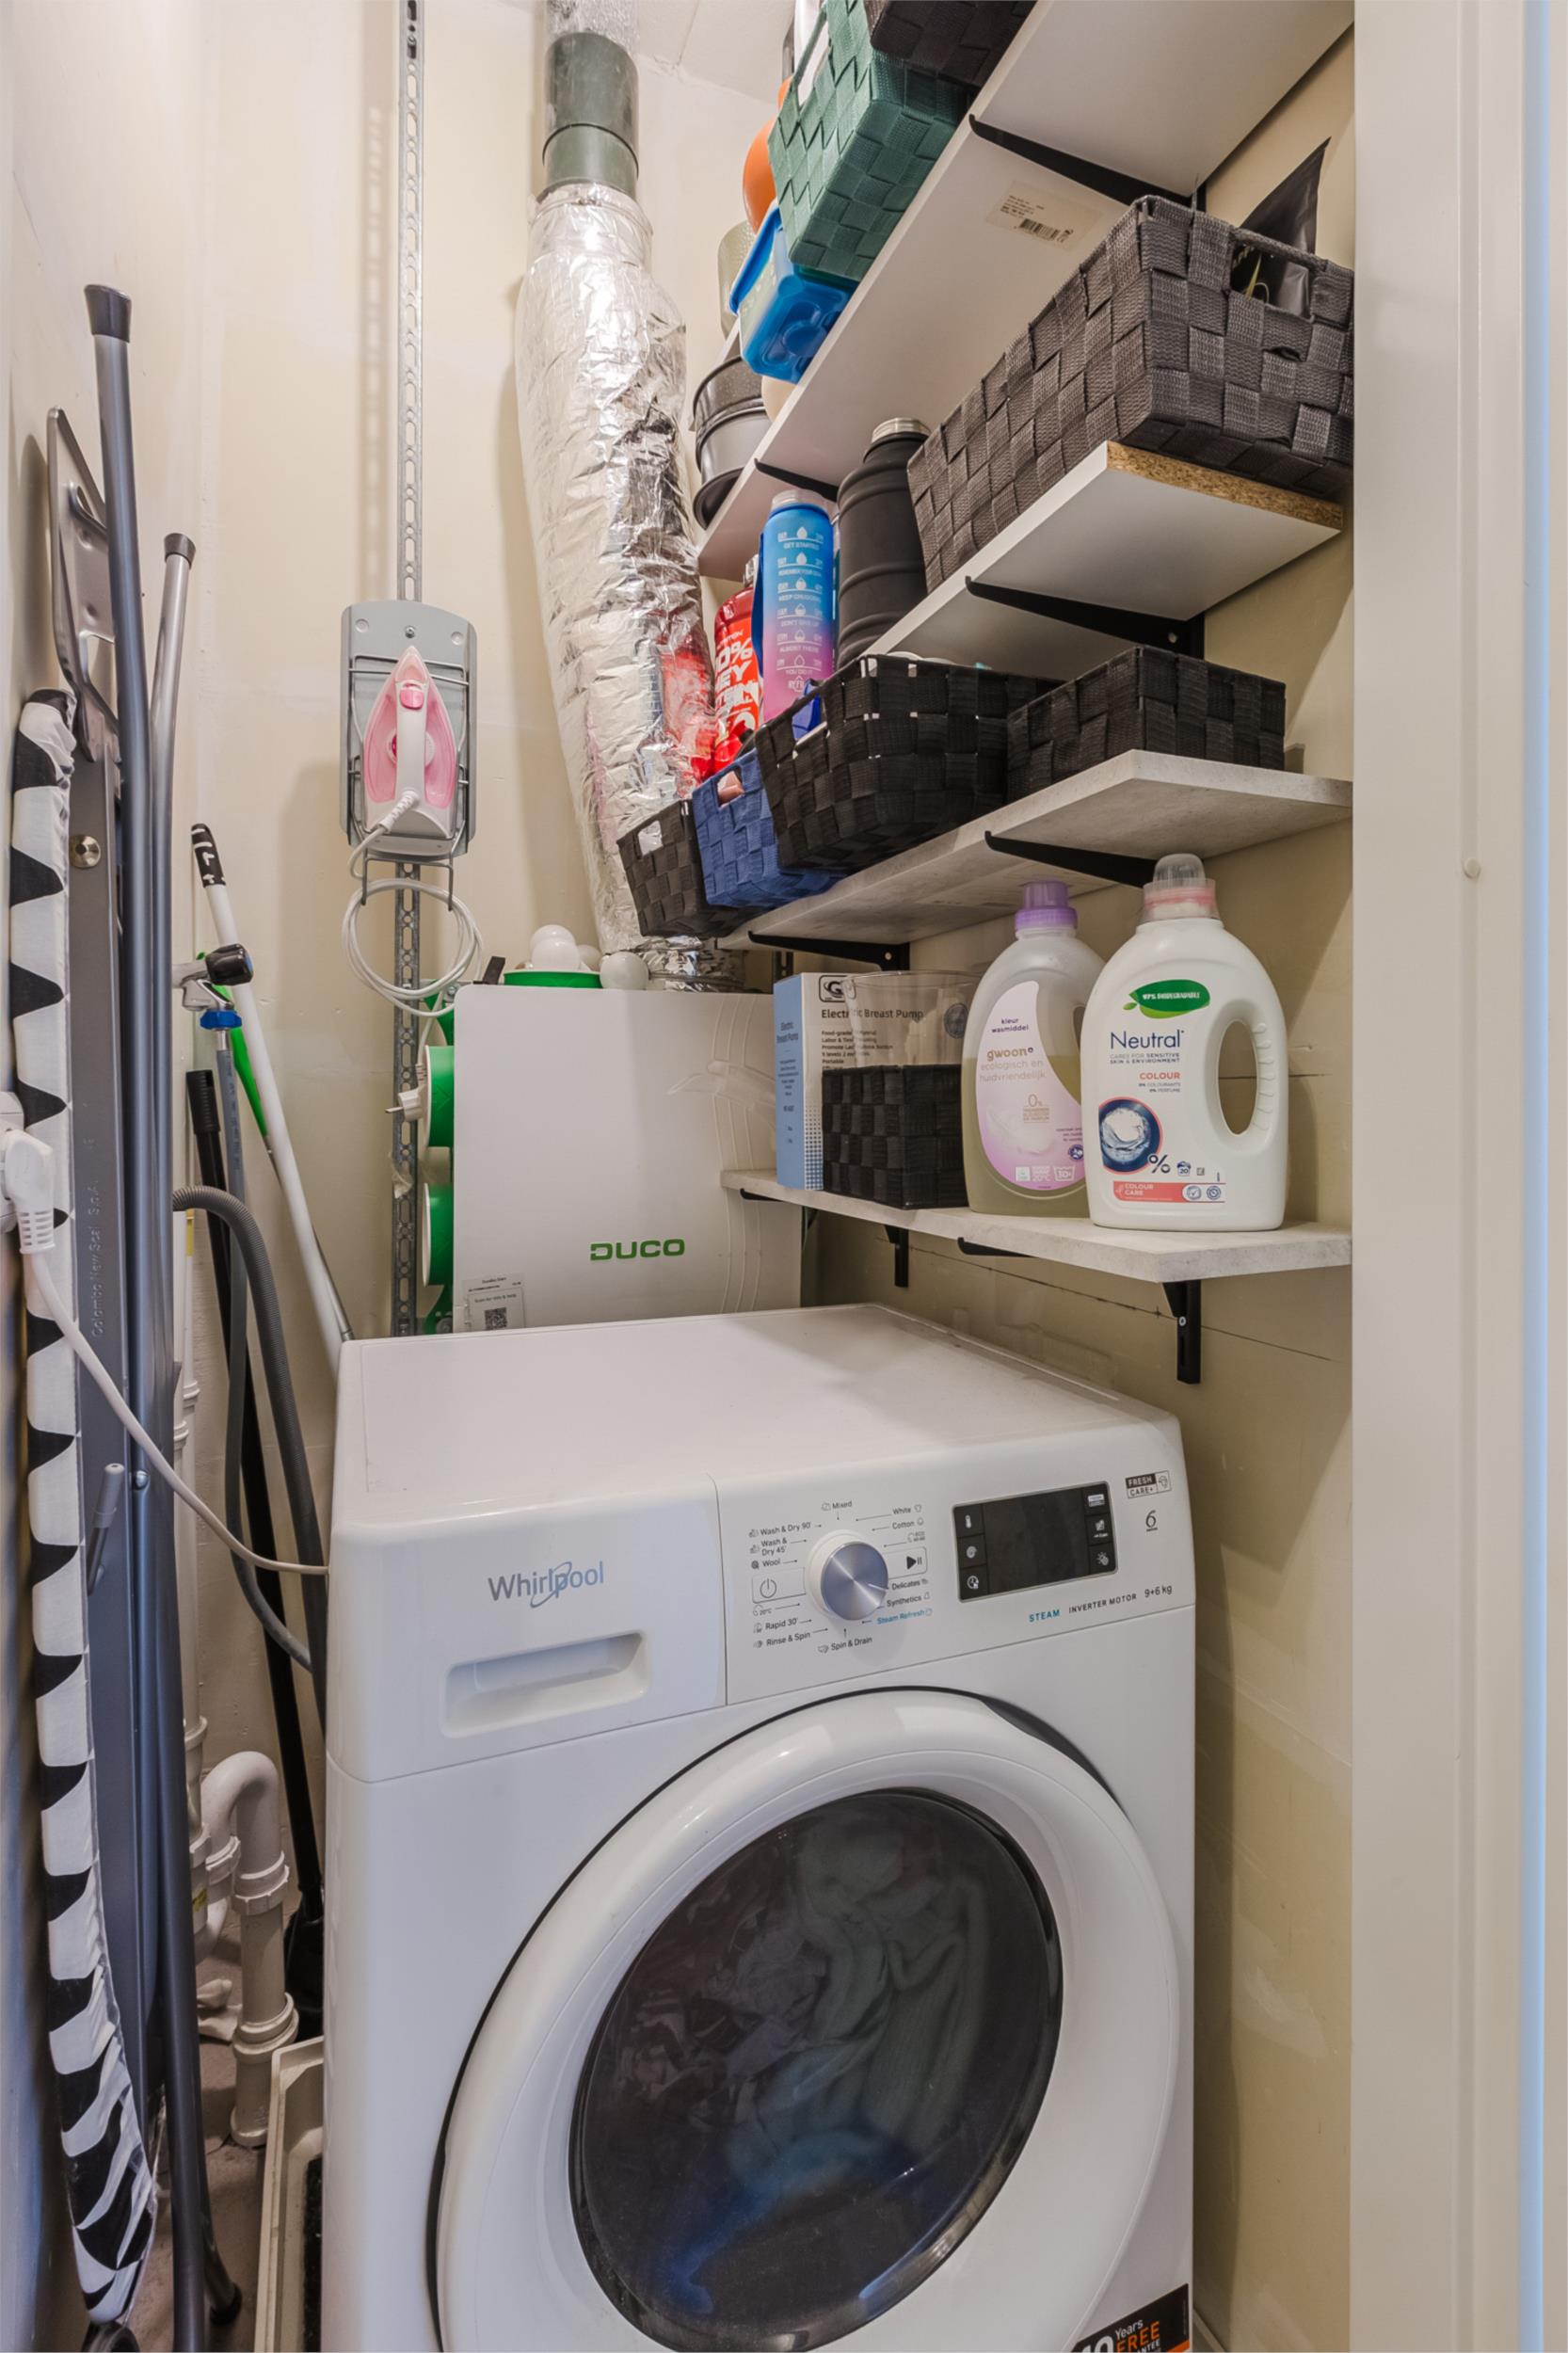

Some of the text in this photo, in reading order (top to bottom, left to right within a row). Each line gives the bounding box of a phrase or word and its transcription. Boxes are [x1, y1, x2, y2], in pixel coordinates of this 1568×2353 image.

[864, 1009, 894, 1018] Breast
[896, 1009, 924, 1021] Pump
[992, 1024, 1029, 1033] wasmiddel
[1110, 1029, 1180, 1049] Neutral
[987, 1048, 1028, 1062] gwoon
[1139, 1072, 1181, 1080] COLOUR
[590, 1238, 685, 1261] DUCO
[1128, 1475, 1153, 1487] FRESH
[1130, 1487, 1154, 1497] CARE+
[892, 1507, 912, 1515] White
[760, 1527, 780, 1536] Wash
[788, 1523, 800, 1533] Dry
[892, 1521, 915, 1529] Cotton
[761, 1539, 781, 1547] Wash
[761, 1548, 775, 1557] Dry
[762, 1559, 781, 1567] Wool
[488, 1561, 603, 1607] Whirlpool
[892, 1581, 920, 1590] Delicates
[1144, 1585, 1172, 1598] 9+6 kg
[887, 1596, 922, 1607] Synthetics
[1029, 1593, 1137, 1623] STEAM INVERTER MOTOR
[877, 1609, 925, 1625] Steam Refresh
[766, 1620, 786, 1630] Rapid
[767, 1637, 787, 1646] Rinse
[794, 1632, 811, 1641] Spin
[831, 1636, 873, 1651] Spin & Drain
[1115, 2320, 1144, 2340] Years
[1117, 2321, 1160, 2352] FREE
